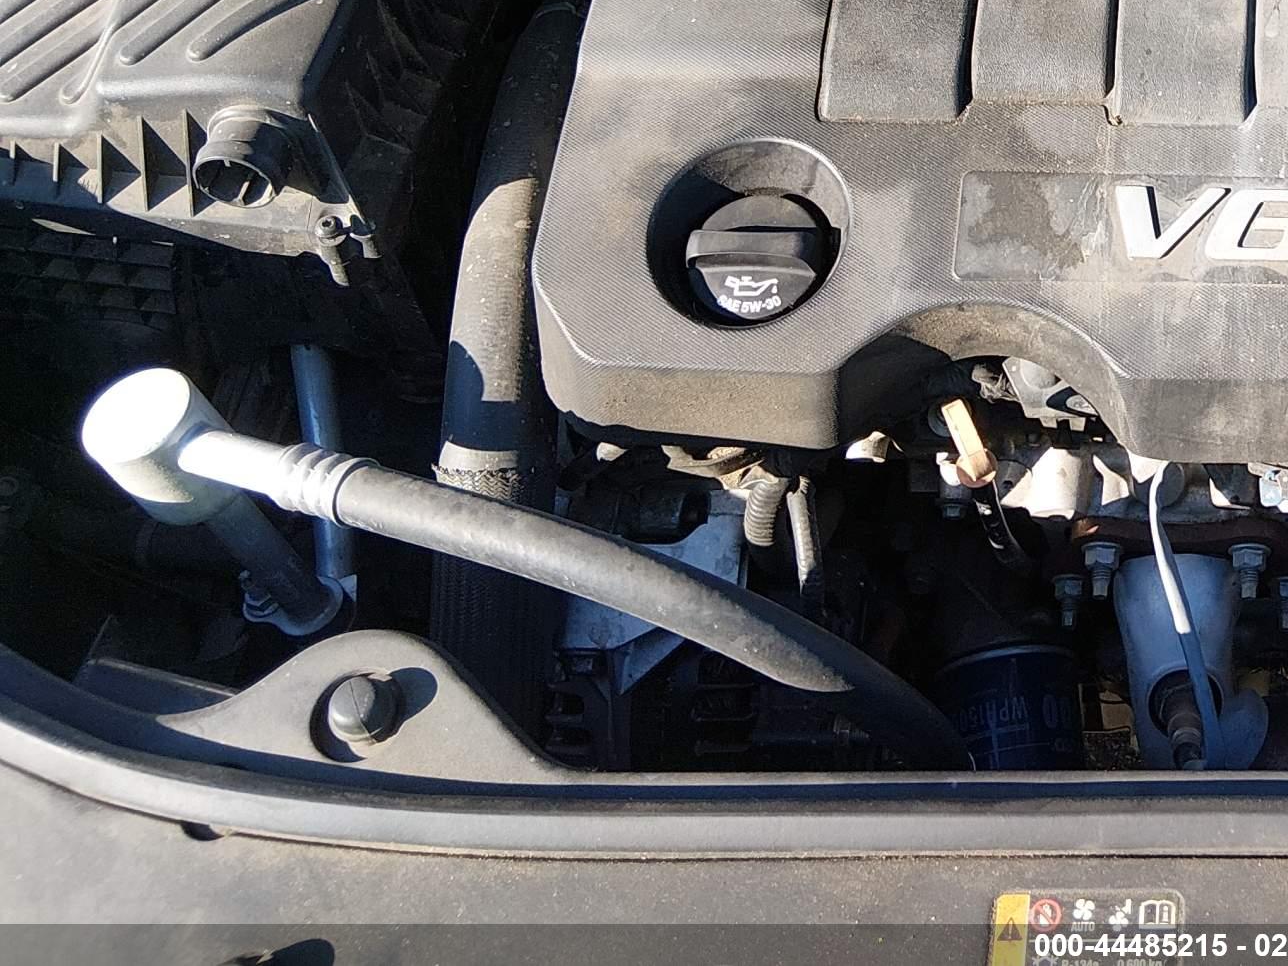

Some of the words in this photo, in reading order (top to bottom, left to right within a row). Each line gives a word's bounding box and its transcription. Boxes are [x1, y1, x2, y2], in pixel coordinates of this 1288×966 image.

[717, 294, 742, 313] SAE
[740, 295, 782, 314] 5W-30
[1071, 921, 1096, 932] AUTO
